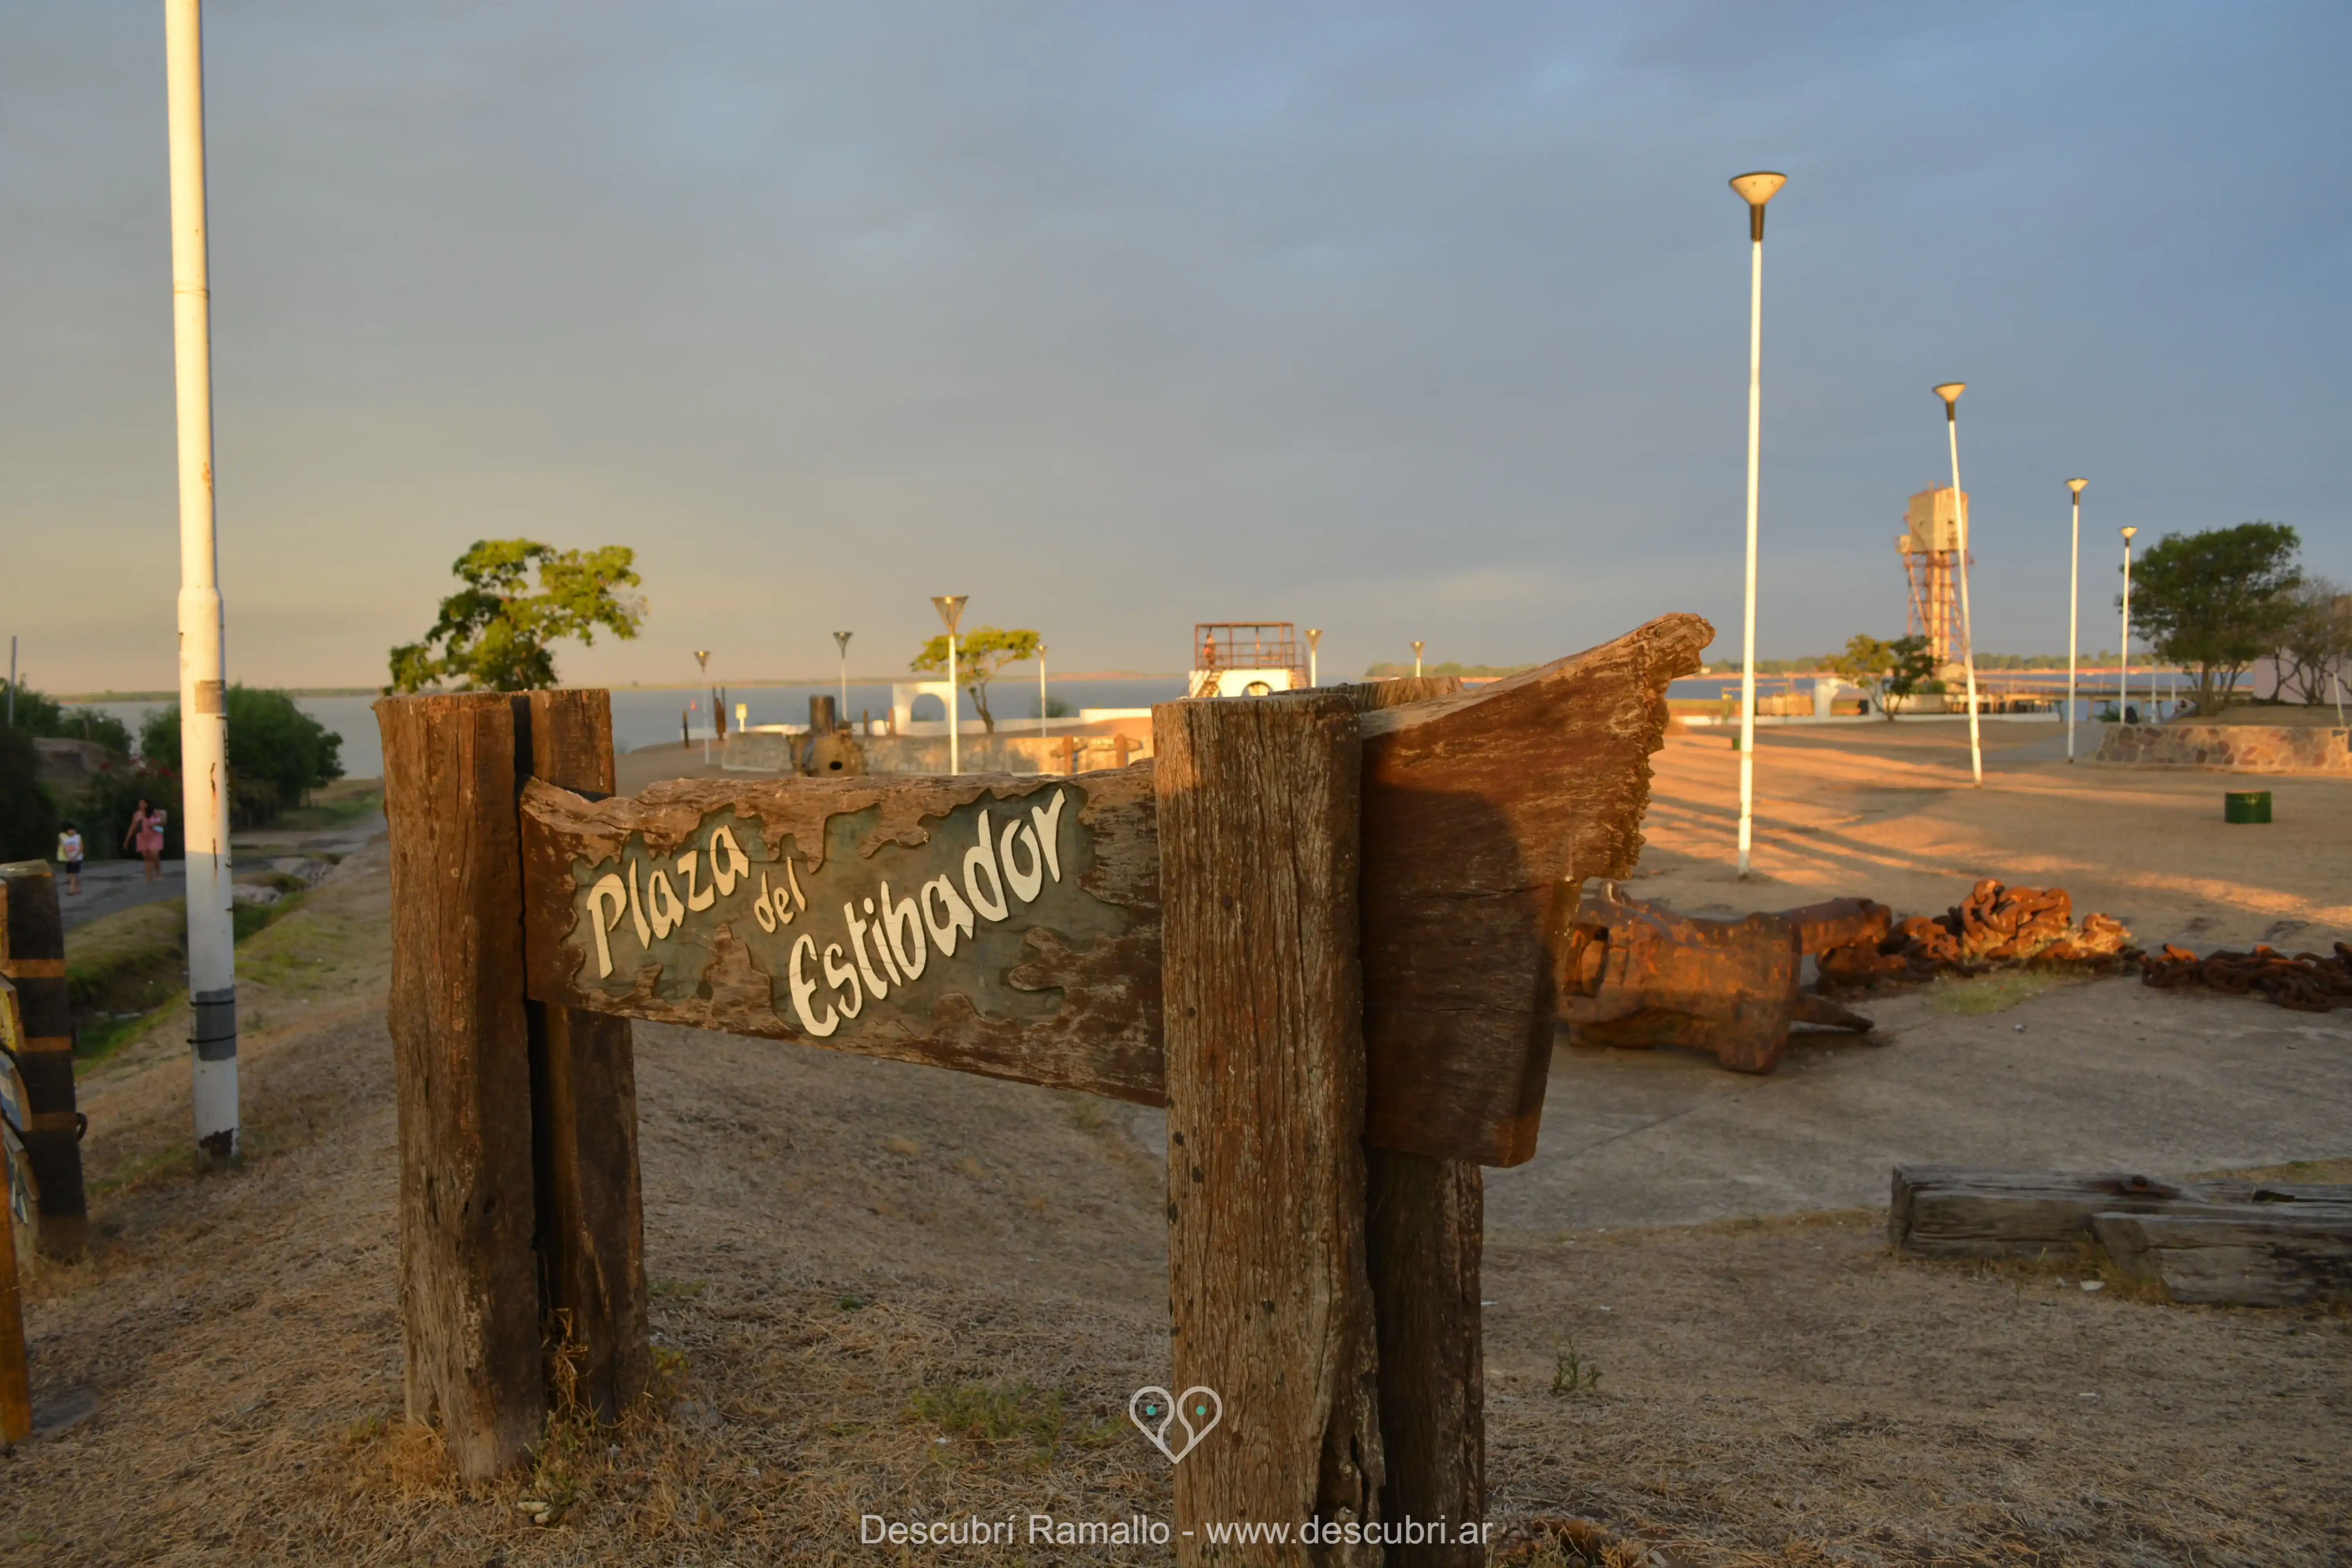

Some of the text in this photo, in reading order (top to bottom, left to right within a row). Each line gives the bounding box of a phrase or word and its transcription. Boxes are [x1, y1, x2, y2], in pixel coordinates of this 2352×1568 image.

[586, 824, 749, 978] Plaza
[754, 856, 806, 933] del
[789, 788, 1066, 1037] Estibador
